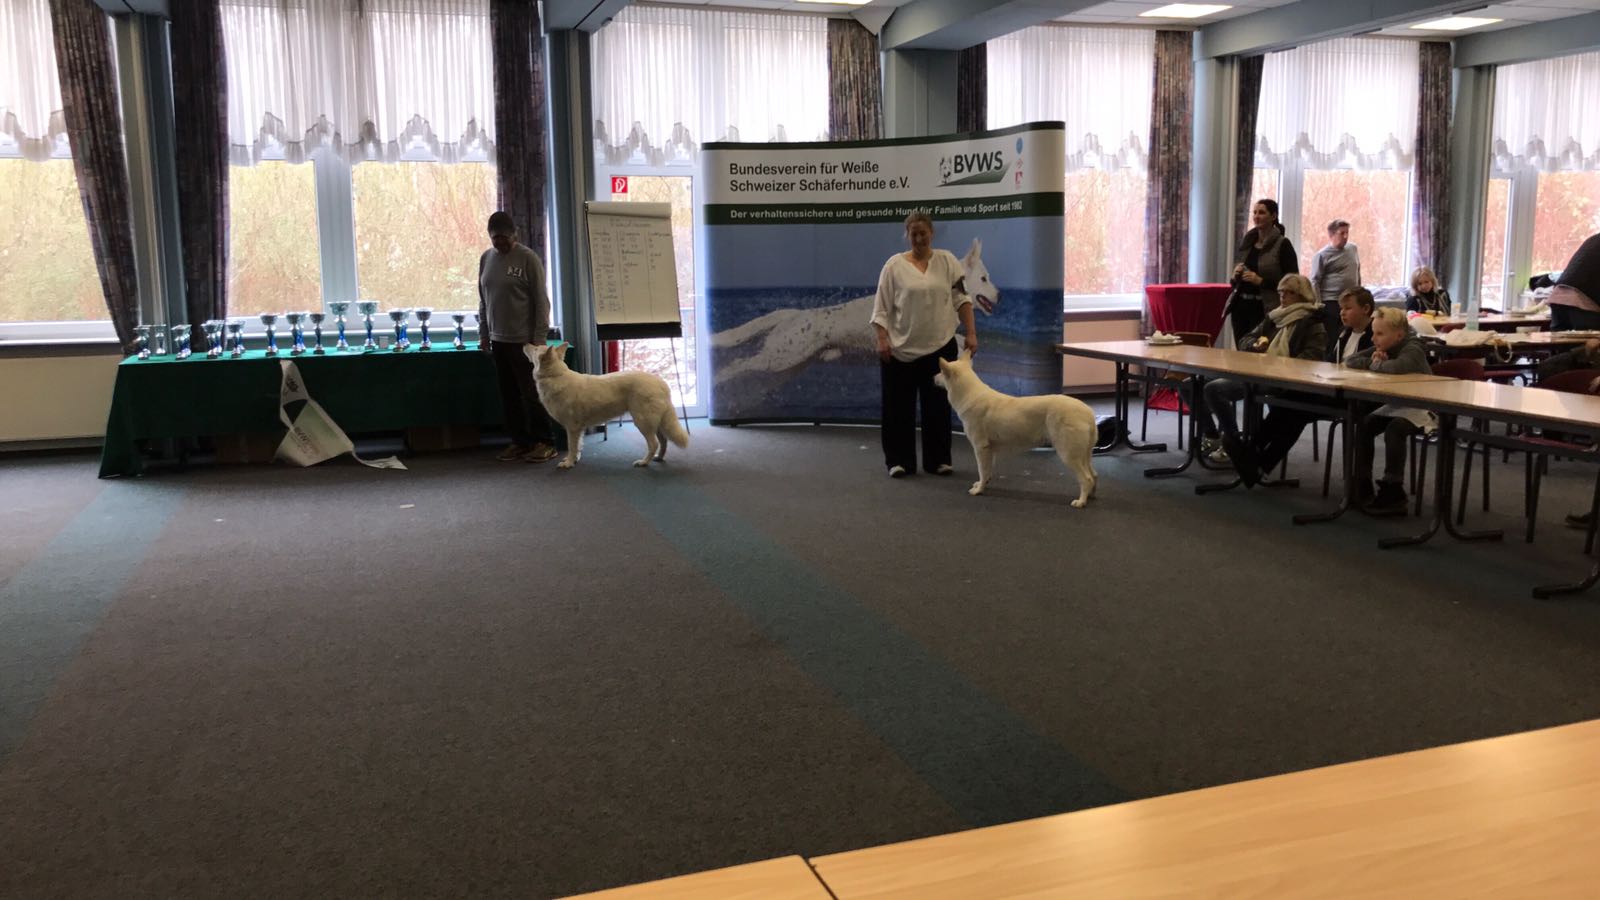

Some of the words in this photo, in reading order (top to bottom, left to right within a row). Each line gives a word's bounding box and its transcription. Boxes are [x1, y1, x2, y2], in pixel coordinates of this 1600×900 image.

[729, 163, 817, 175] Bundesverein
[820, 162, 839, 174] für
[841, 160, 880, 174] Weiße
[953, 151, 1004, 173] BVWS
[729, 179, 797, 192] Schweizer
[799, 177, 887, 191] Schäferhunde
[889, 175, 911, 189] e.V.
[730, 209, 748, 219] Der
[749, 208, 834, 219] verhaltenssichere
[836, 208, 854, 218] und
[855, 207, 894, 220] gesunde
[895, 206, 919, 216] Hund
[935, 204, 962, 215] Familie
[964, 203, 977, 213] und
[978, 202, 999, 214] Sport
[1000, 201, 1011, 211] seit
